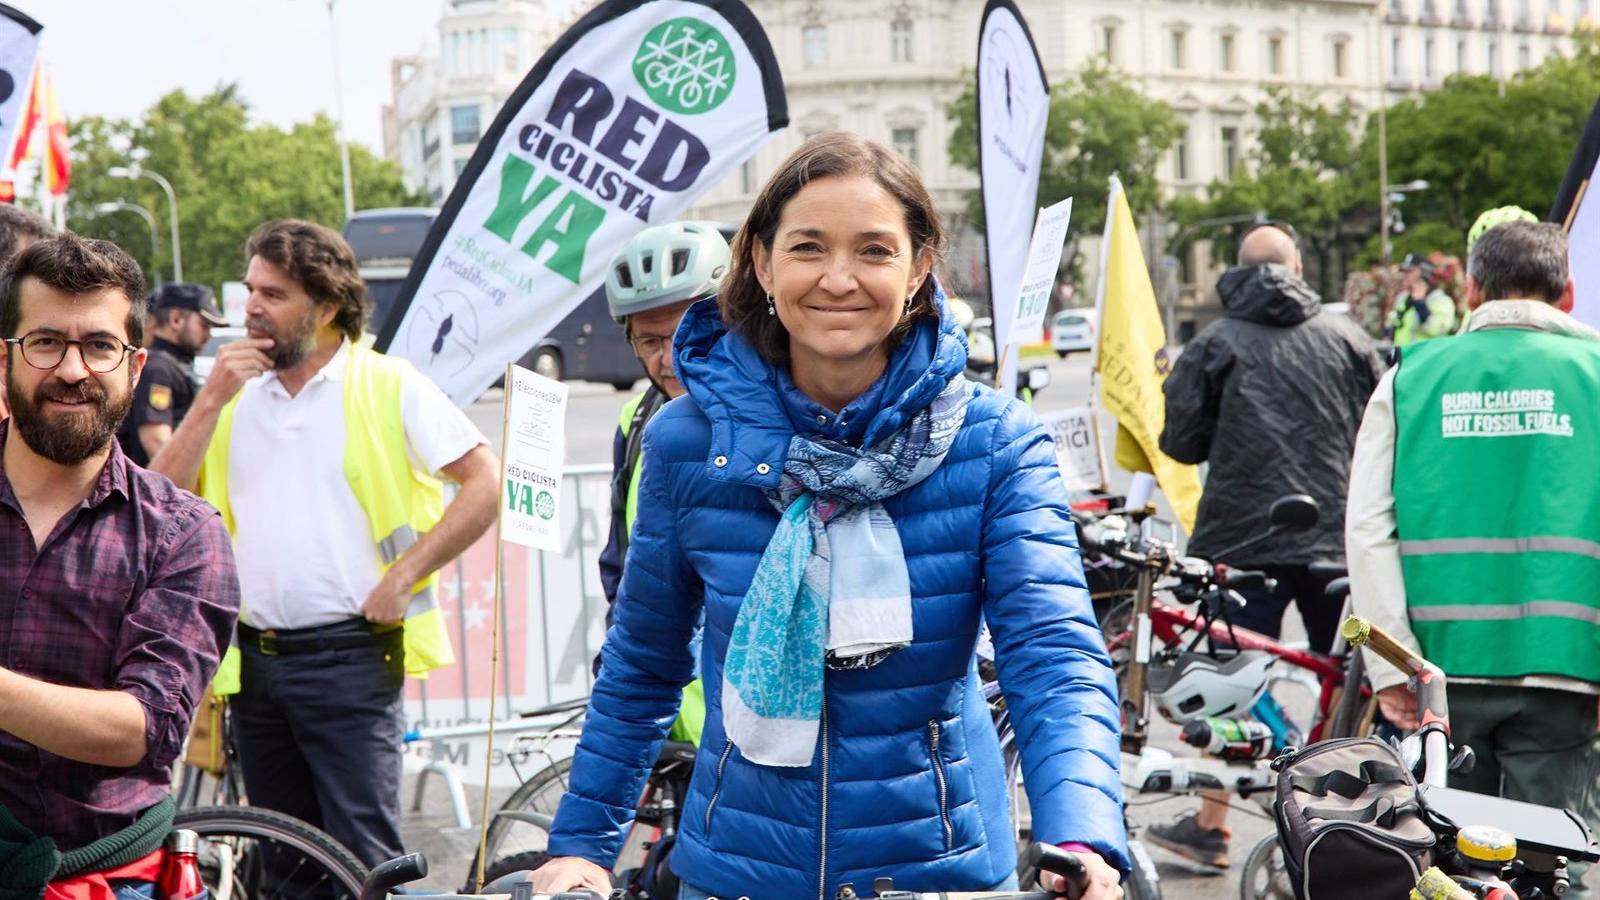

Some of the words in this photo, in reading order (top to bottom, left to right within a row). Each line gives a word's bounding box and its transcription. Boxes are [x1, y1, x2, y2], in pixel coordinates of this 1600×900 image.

[545, 68, 710, 192] RED
[519, 124, 656, 223] CICLISTA
[482, 152, 607, 286] YA
[1442, 392, 1482, 410] BURN
[1485, 389, 1555, 408] CALORIES
[1052, 416, 1086, 431] VOTA
[1443, 414, 1472, 433] NOT
[1473, 413, 1523, 432] FOSSIL
[1055, 429, 1089, 452] BICI
[522, 469, 556, 488] CICLISTA
[507, 479, 533, 516] YA
